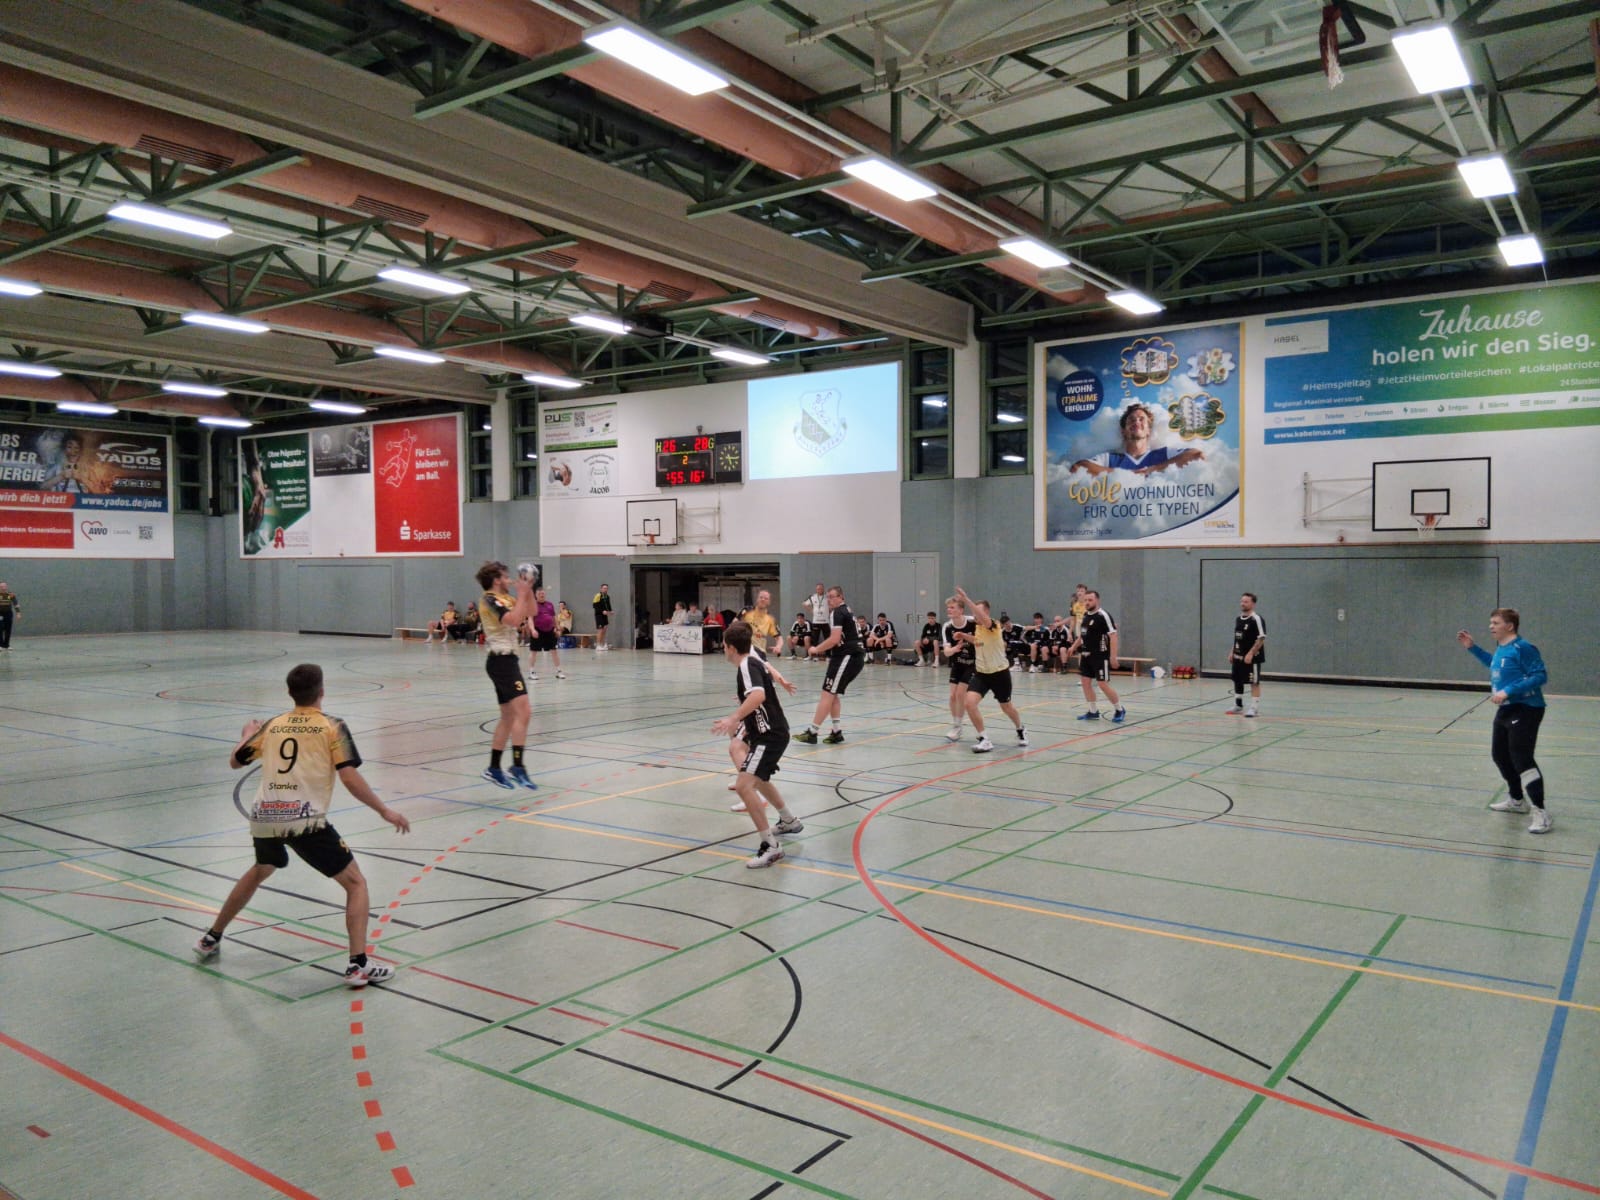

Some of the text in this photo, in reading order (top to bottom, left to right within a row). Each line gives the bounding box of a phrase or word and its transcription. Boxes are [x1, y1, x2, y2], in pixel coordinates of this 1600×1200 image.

[1418, 304, 1544, 341] Zuhause
[1372, 332, 1596, 366] holen wir den Sieg.
[1302, 378, 1371, 391] #Heimspieltag
[1378, 367, 1511, 385] #JetztHeimvorteilesichern
[662, 439, 677, 453] 26
[694, 437, 709, 451] 28
[96, 452, 162, 466] YADOS
[682, 455, 688, 465] 2
[1069, 474, 1214, 505] coole WOHNUNGEN
[1083, 502, 1200, 518] FÜR COOLE TYPEN
[413, 529, 452, 542] Sparkasse
[515, 680, 524, 691] 3
[287, 716, 312, 724] TBSV
[278, 737, 299, 774] 9
